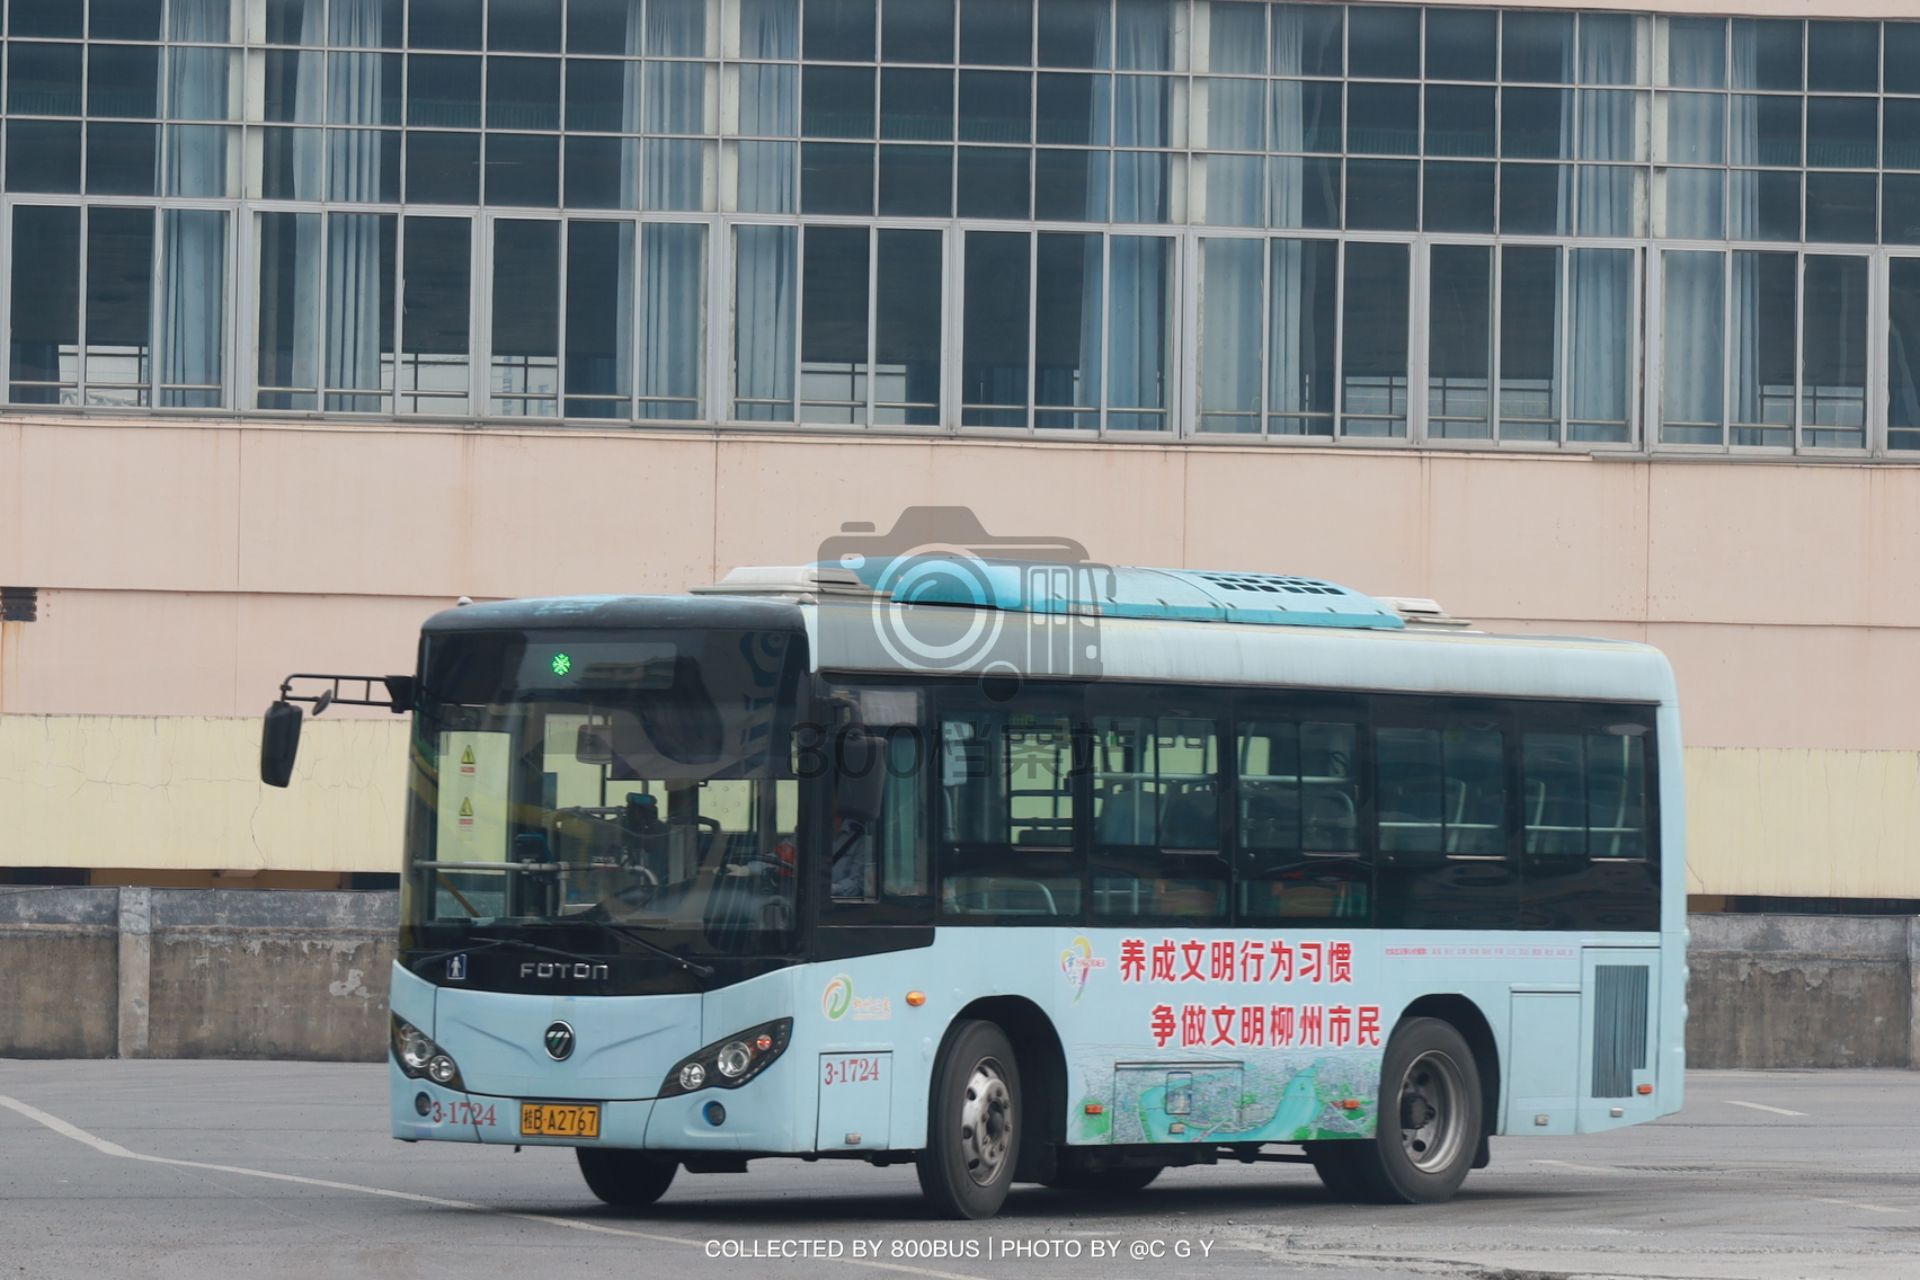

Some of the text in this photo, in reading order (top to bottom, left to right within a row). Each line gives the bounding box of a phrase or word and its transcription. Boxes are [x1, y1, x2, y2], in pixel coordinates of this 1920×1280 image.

[519, 961, 609, 981] FOTON
[1119, 938, 1353, 984] 养成文明行为习惯
[1150, 1004, 1381, 1048] 争做文明柳州市民
[823, 1056, 881, 1086] 3-1724
[431, 1101, 498, 1127] 3-1724
